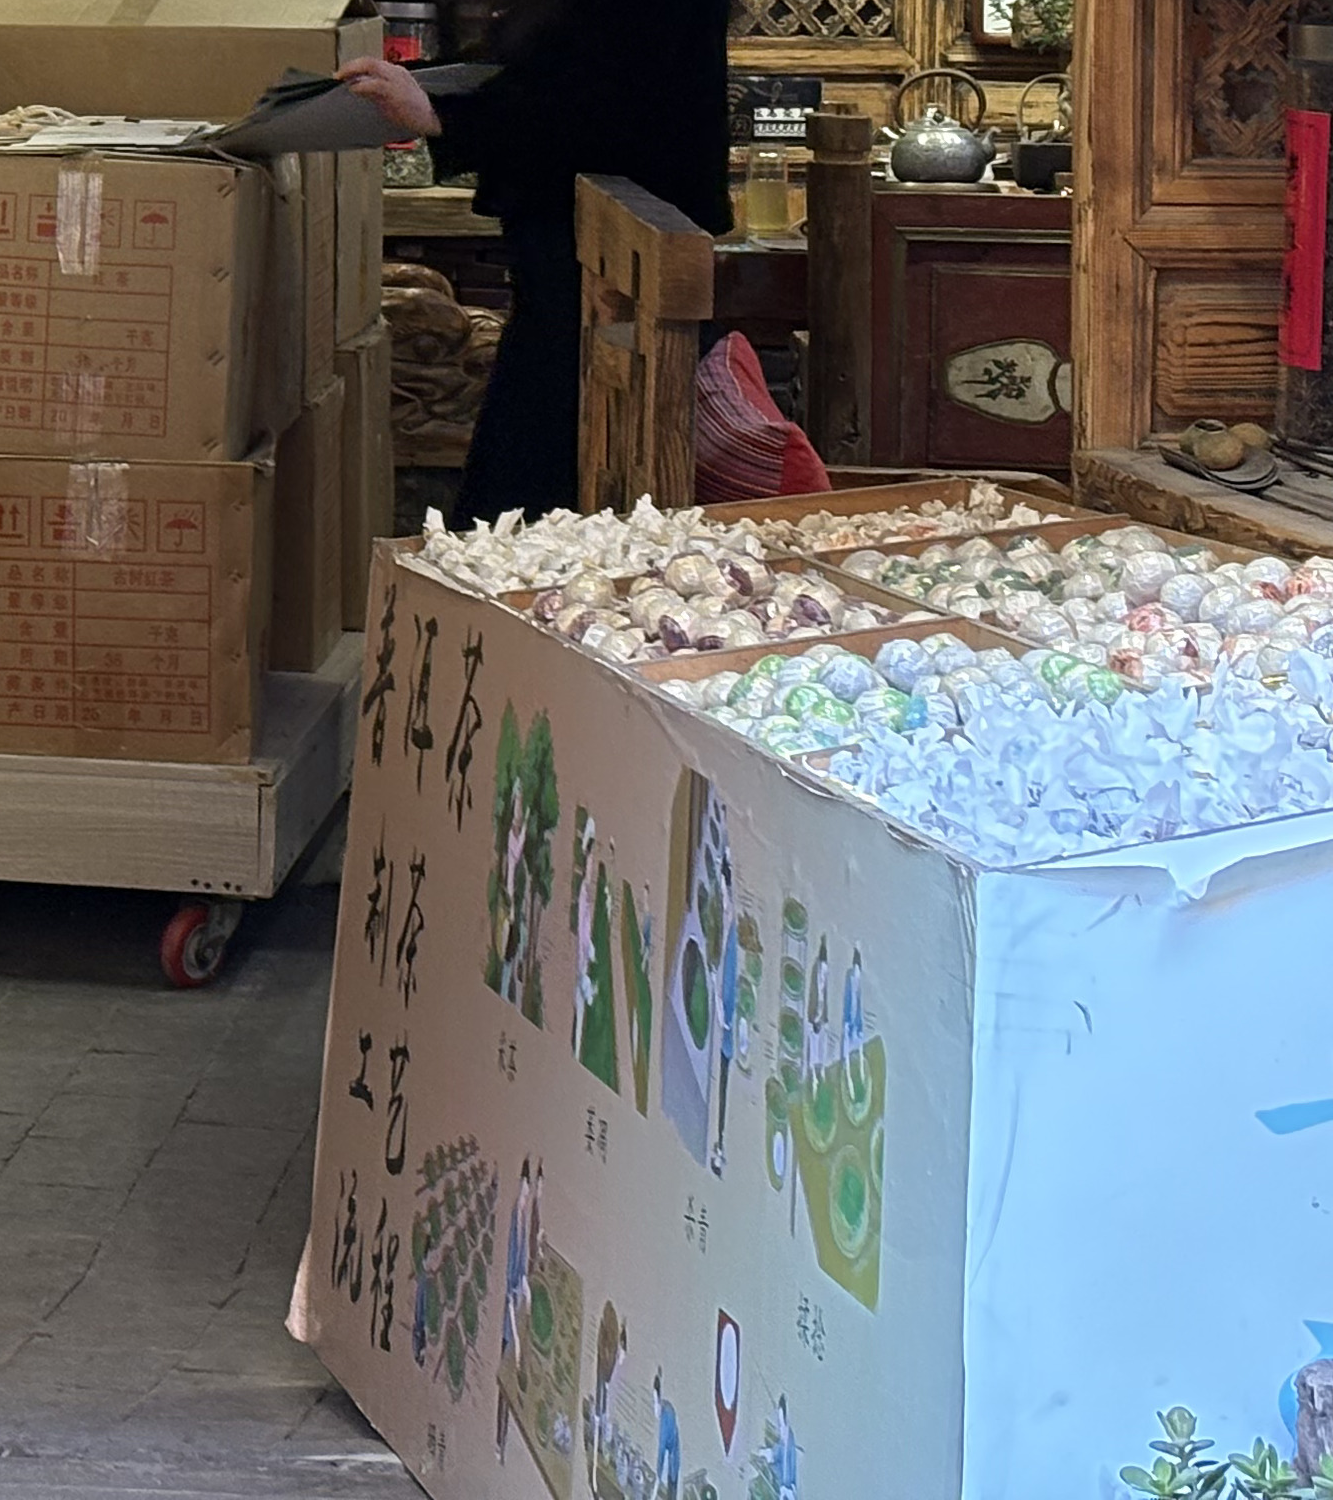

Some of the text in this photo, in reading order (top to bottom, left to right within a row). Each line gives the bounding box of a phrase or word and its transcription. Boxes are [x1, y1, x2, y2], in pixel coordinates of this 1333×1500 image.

[126, 329, 155, 348] 千克
[150, 413, 161, 430] 日
[148, 625, 179, 644] 千克
[150, 654, 180, 672] 个月
[159, 708, 173, 725] 月
[190, 710, 203, 727] 日
[361, 582, 484, 834] 普洱茶
[363, 813, 425, 1010] 制茶
[349, 1027, 411, 1176] 工艺
[331, 1168, 400, 1353] 流程
